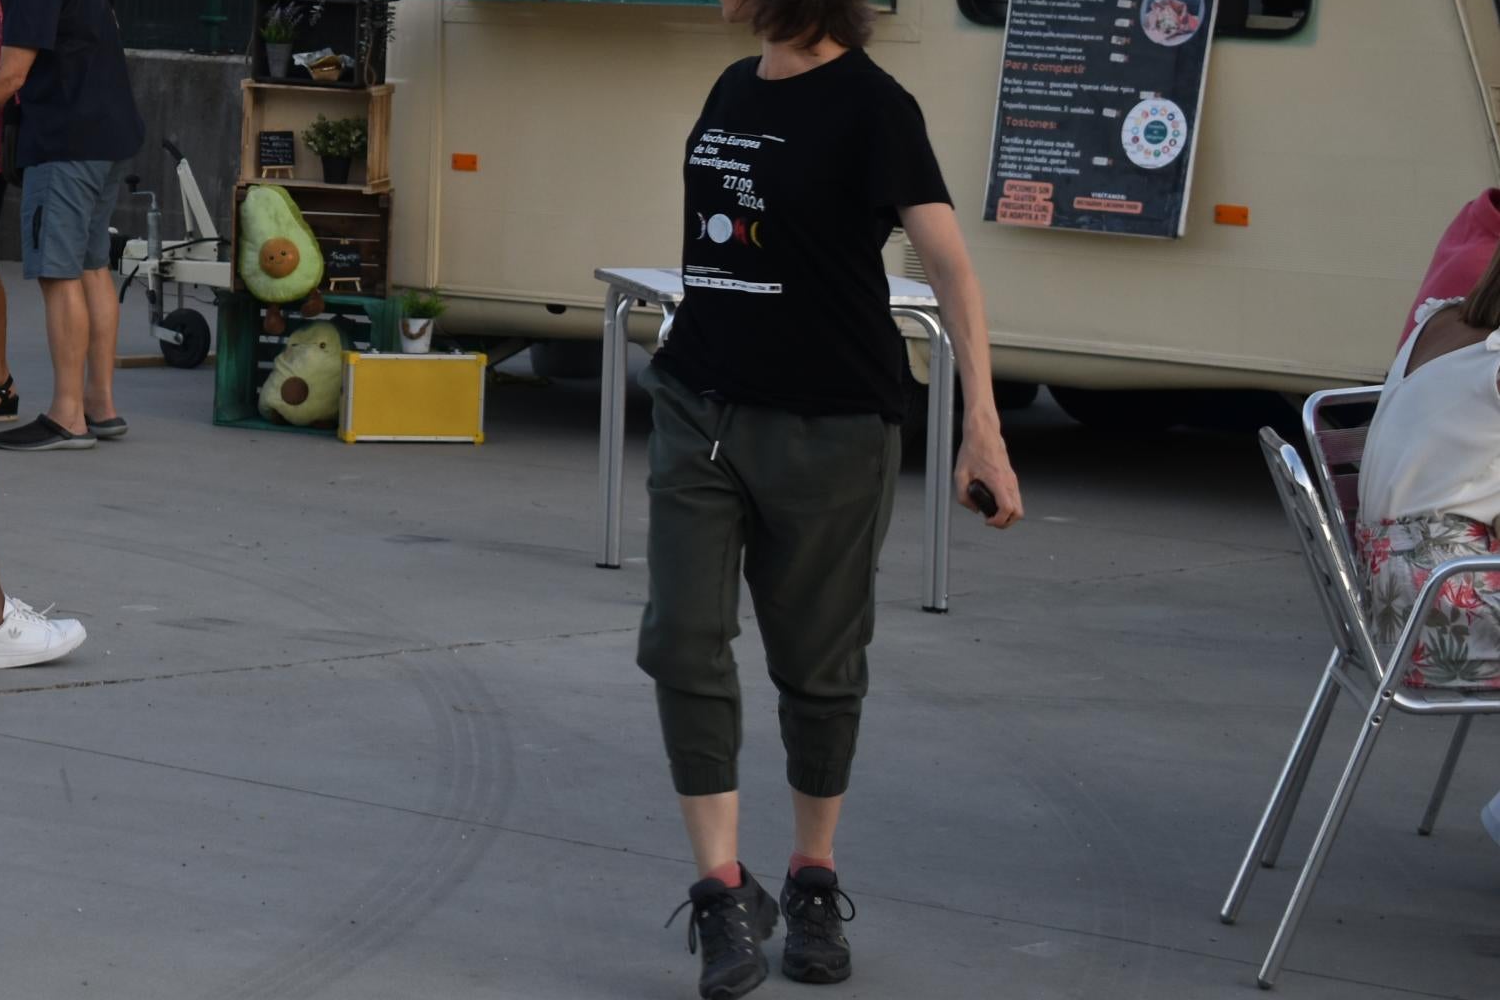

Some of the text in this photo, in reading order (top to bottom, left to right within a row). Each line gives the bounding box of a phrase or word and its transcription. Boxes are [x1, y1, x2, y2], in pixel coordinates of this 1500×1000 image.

[1004, 60, 1085, 75] Para compartir
[693, 144, 719, 155] de los
[700, 133, 761, 149] Noche Europea
[689, 154, 751, 172] Investigadores
[723, 174, 755, 194] 27.09.
[737, 192, 765, 211] 2024
